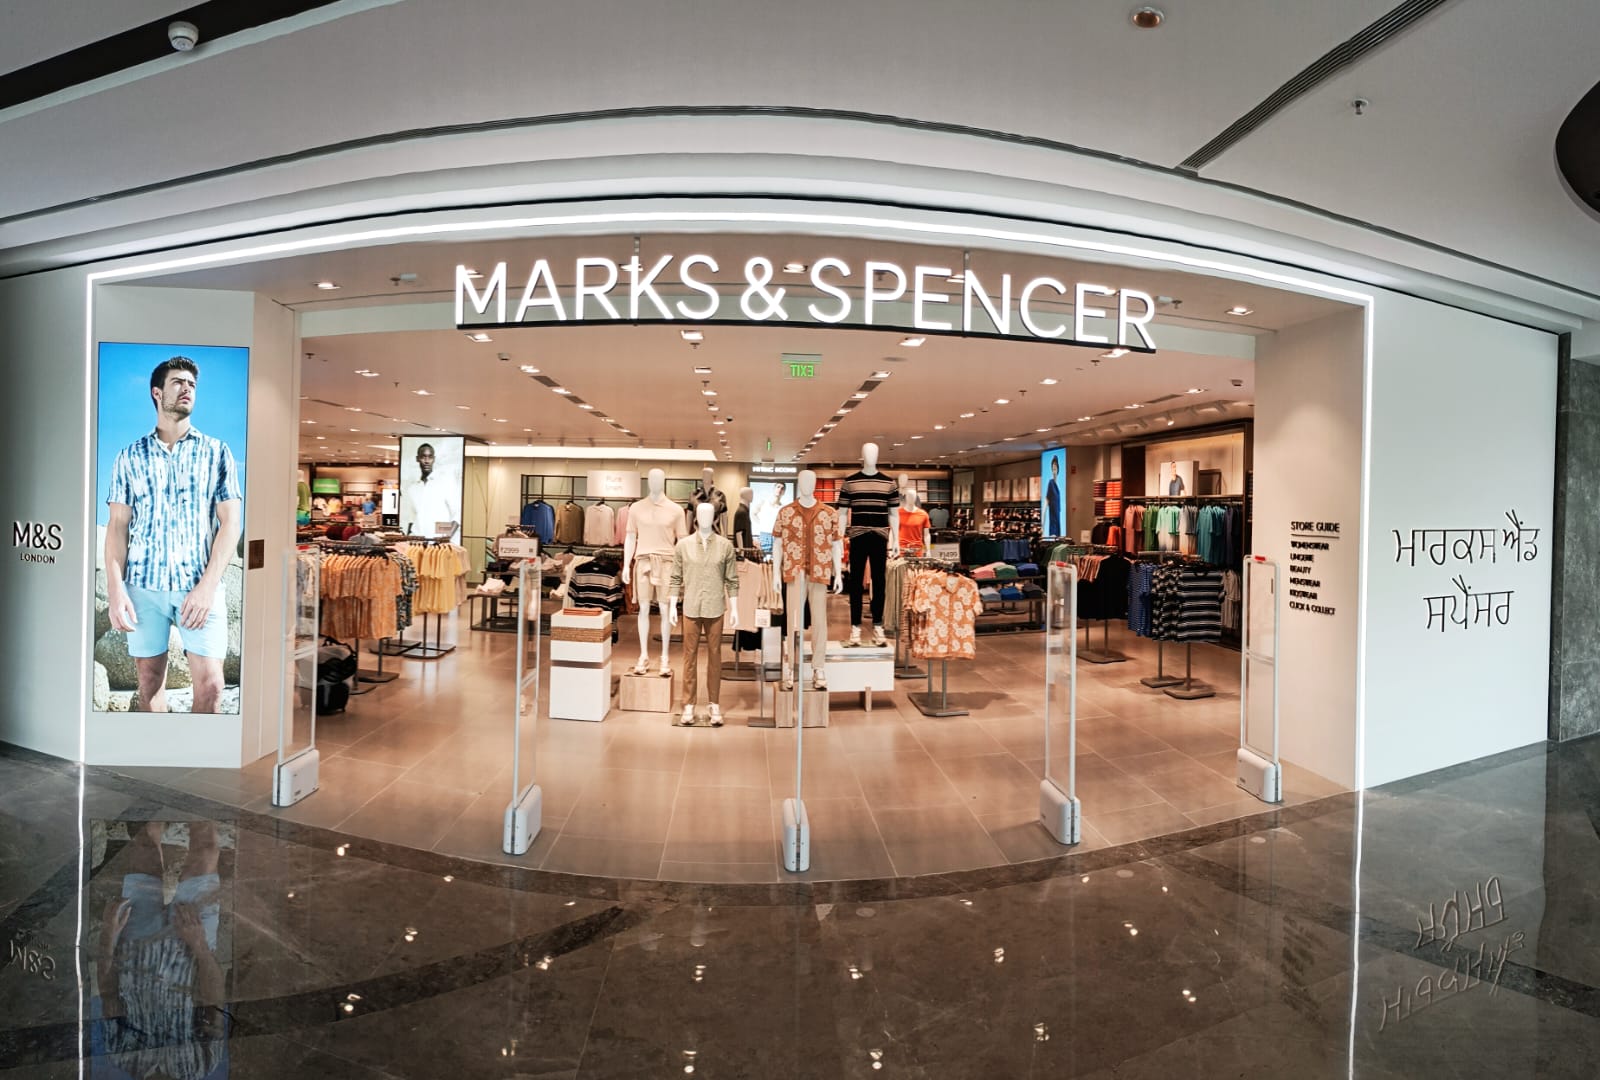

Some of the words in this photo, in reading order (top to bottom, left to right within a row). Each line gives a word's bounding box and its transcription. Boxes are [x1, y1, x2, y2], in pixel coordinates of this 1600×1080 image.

[455, 254, 720, 325] MARKS
[740, 256, 789, 321] &
[807, 257, 1157, 350] SPENCER
[1290, 521, 1314, 531] STORE
[1316, 522, 1340, 533] GUIDE
[13, 521, 63, 551] M&S
[1290, 540, 1330, 550] WOMENSWEAR
[1392, 529, 1496, 566] ਮਾਰਕਸ
[20, 553, 55, 564] LONDON
[1289, 565, 1311, 574] BEAUTY
[1289, 577, 1321, 588] MENSWEAR
[1289, 601, 1305, 610] CLICK
[1311, 604, 1336, 615] COLLECT
